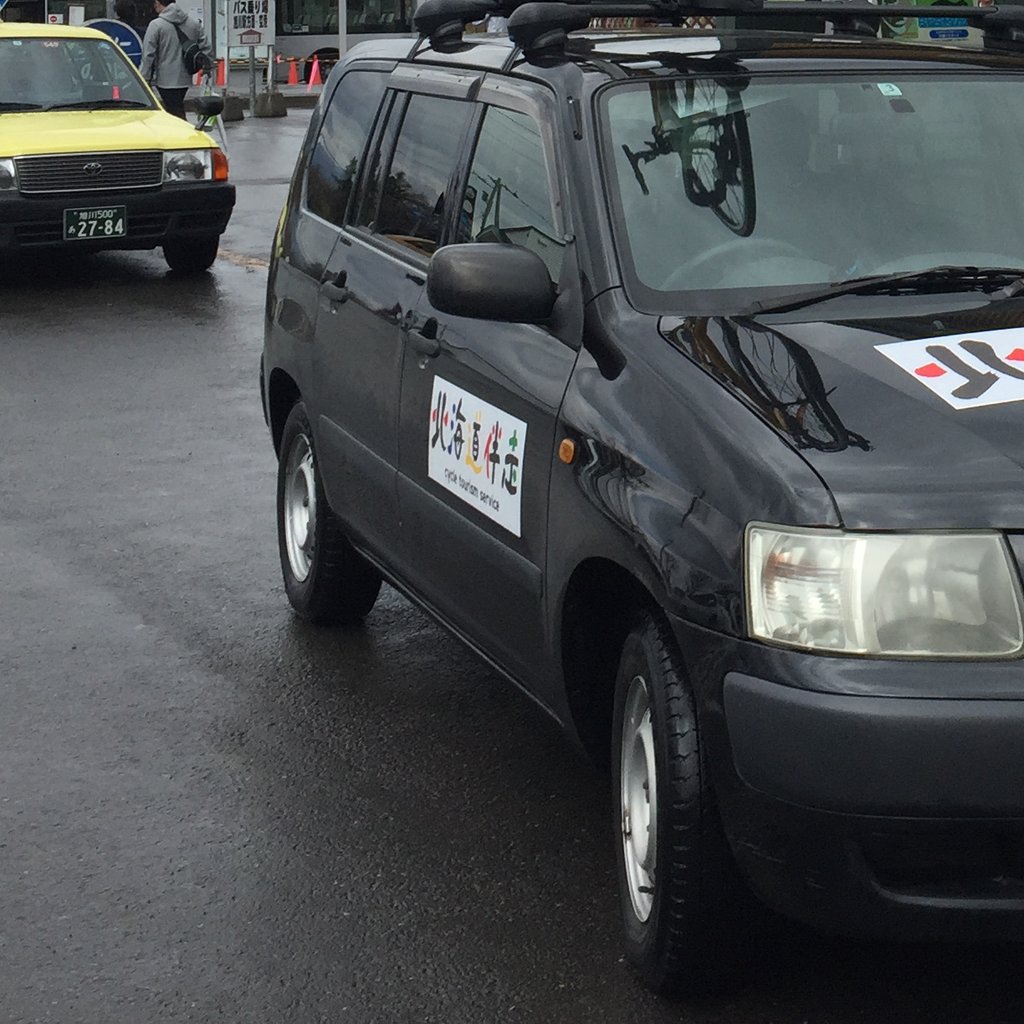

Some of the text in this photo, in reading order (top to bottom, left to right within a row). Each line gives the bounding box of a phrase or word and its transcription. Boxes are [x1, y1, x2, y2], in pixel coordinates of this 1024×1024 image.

[79, 209, 114, 220] 旭川500
[77, 218, 124, 237] 27-84
[444, 467, 500, 512] cycle tourism service
